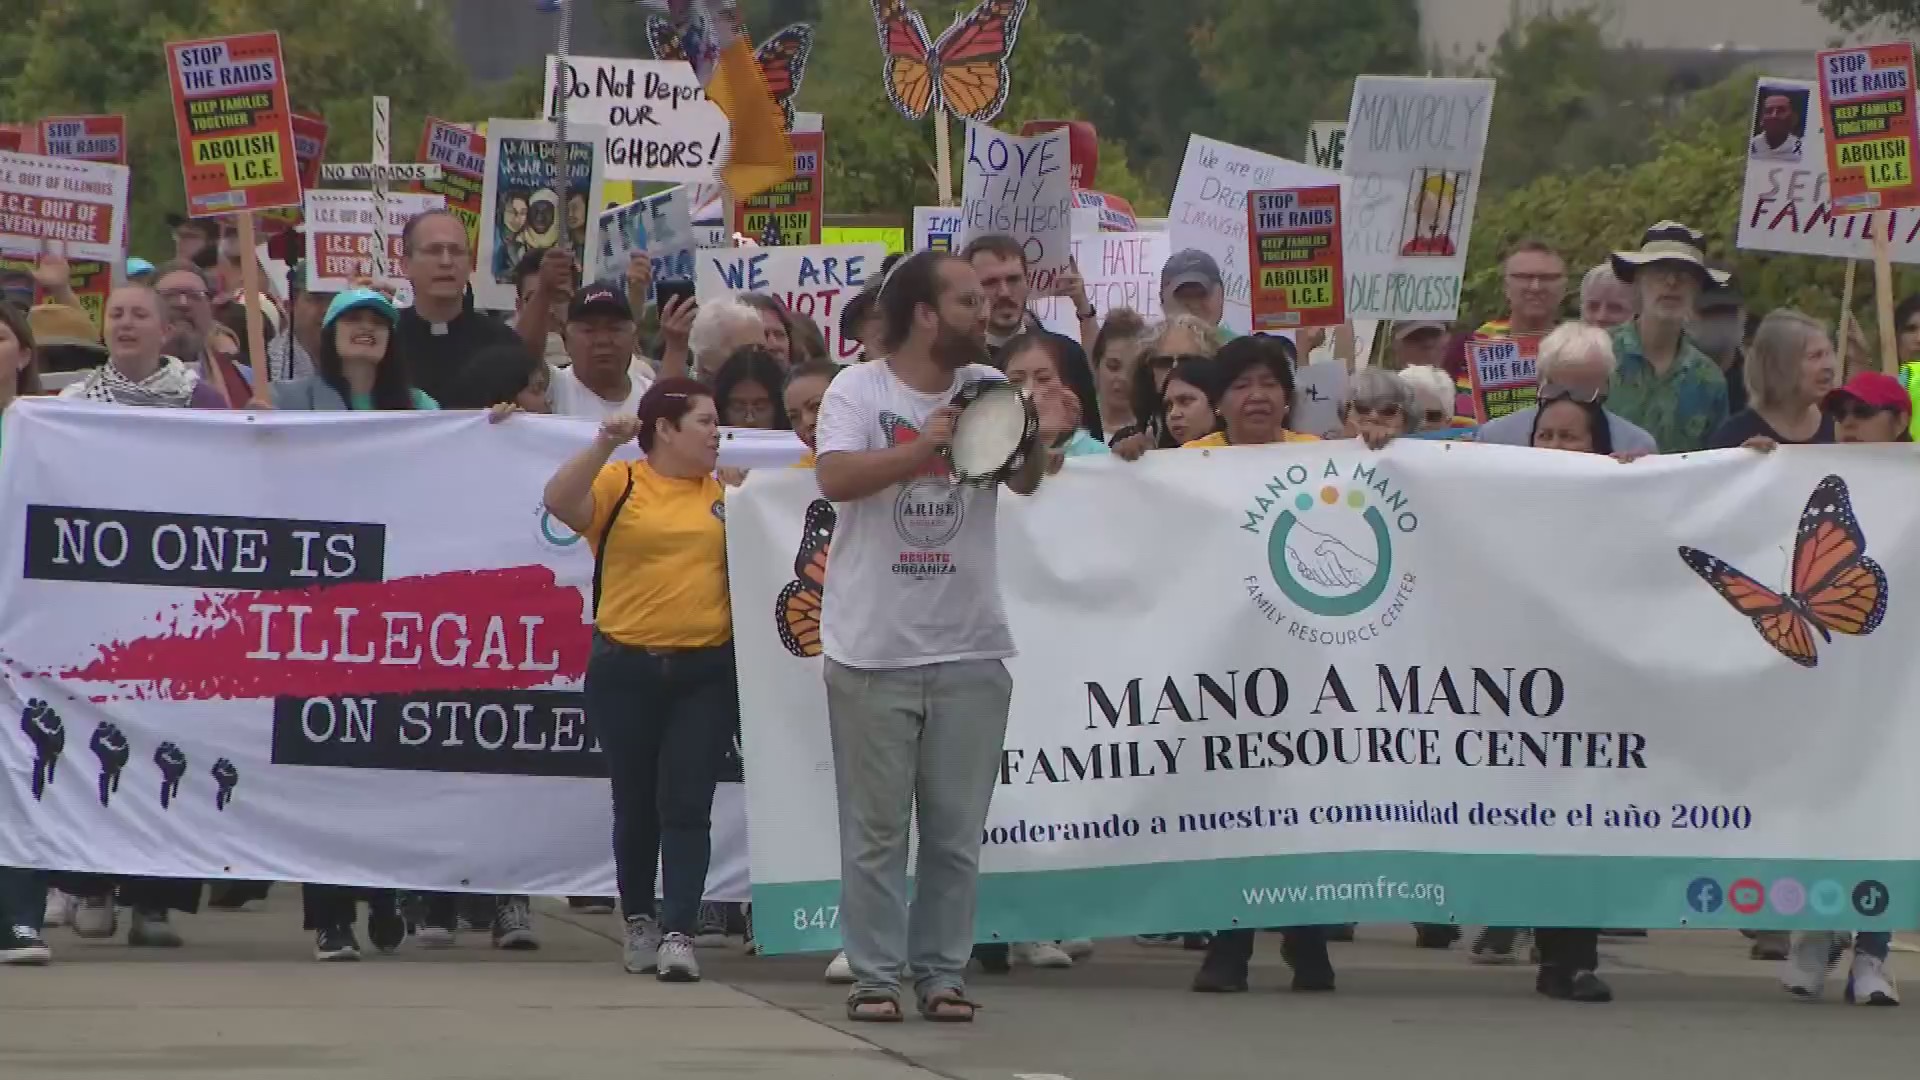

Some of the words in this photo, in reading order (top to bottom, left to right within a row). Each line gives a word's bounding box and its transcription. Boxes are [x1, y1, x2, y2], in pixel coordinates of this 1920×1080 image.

[181, 46, 222, 67] STOP
[1829, 54, 1866, 74] STOP
[183, 70, 215, 90] THE
[220, 62, 273, 86] RAIDS
[597, 64, 636, 98] Not
[645, 72, 707, 110] Depor
[1831, 78, 1857, 96] THE
[1862, 71, 1907, 92] RAIDS
[610, 106, 661, 126] OUR
[1351, 94, 1485, 151] MONOPOLY
[48, 123, 81, 138] STOP
[435, 127, 468, 147] STOP
[200, 136, 275, 160] ABOLISH
[430, 142, 454, 162] THE
[605, 132, 721, 168] IGHBORS!
[968, 127, 1061, 176] LOVE
[1841, 140, 1907, 163] ABOLISH
[233, 158, 279, 180] I.C.E.
[1871, 162, 1909, 183] I.C.E.
[979, 173, 1045, 203] THY
[40, 201, 75, 220] OUT
[77, 204, 99, 221] OF
[1259, 194, 1293, 210] STOP
[1258, 212, 1285, 228] THE
[1289, 210, 1333, 227] RAIDS
[713, 252, 769, 290] WE
[798, 255, 866, 287] ARE
[1264, 268, 1329, 287] ABOLISH
[1292, 287, 1330, 304] I.C.E.
[1479, 343, 1514, 363] STOP
[1480, 362, 1507, 381] THE
[1240, 465, 1308, 534] MANO
[1323, 458, 1339, 479] A
[1352, 462, 1418, 533] MANO
[904, 502, 956, 517] ARISE
[52, 517, 129, 568] NO
[151, 524, 269, 573] ONE
[290, 531, 357, 578] IS
[1243, 575, 1287, 625] FAMILY
[1287, 621, 1380, 646] RESOURCE
[1381, 572, 1417, 627] CENTER
[246, 604, 560, 671] ILLEGAL
[1084, 667, 1289, 729] MANO
[1310, 663, 1358, 714] A
[1376, 663, 1565, 718] MANO
[301, 697, 377, 744] ON
[1000, 738, 1187, 785] FAMILY
[1202, 727, 1442, 772] RESOURCE
[1455, 729, 1648, 769] CENTER
[1150, 814, 1167, 834] a
[1178, 806, 1299, 833] nuestra
[1308, 799, 1459, 826] comunidad
[1468, 801, 1557, 828] desde
[1567, 803, 1593, 829] el
[1604, 803, 1661, 829] año
[1671, 804, 1752, 830] 2000
[1242, 875, 1445, 907] www.mamfrc.org
